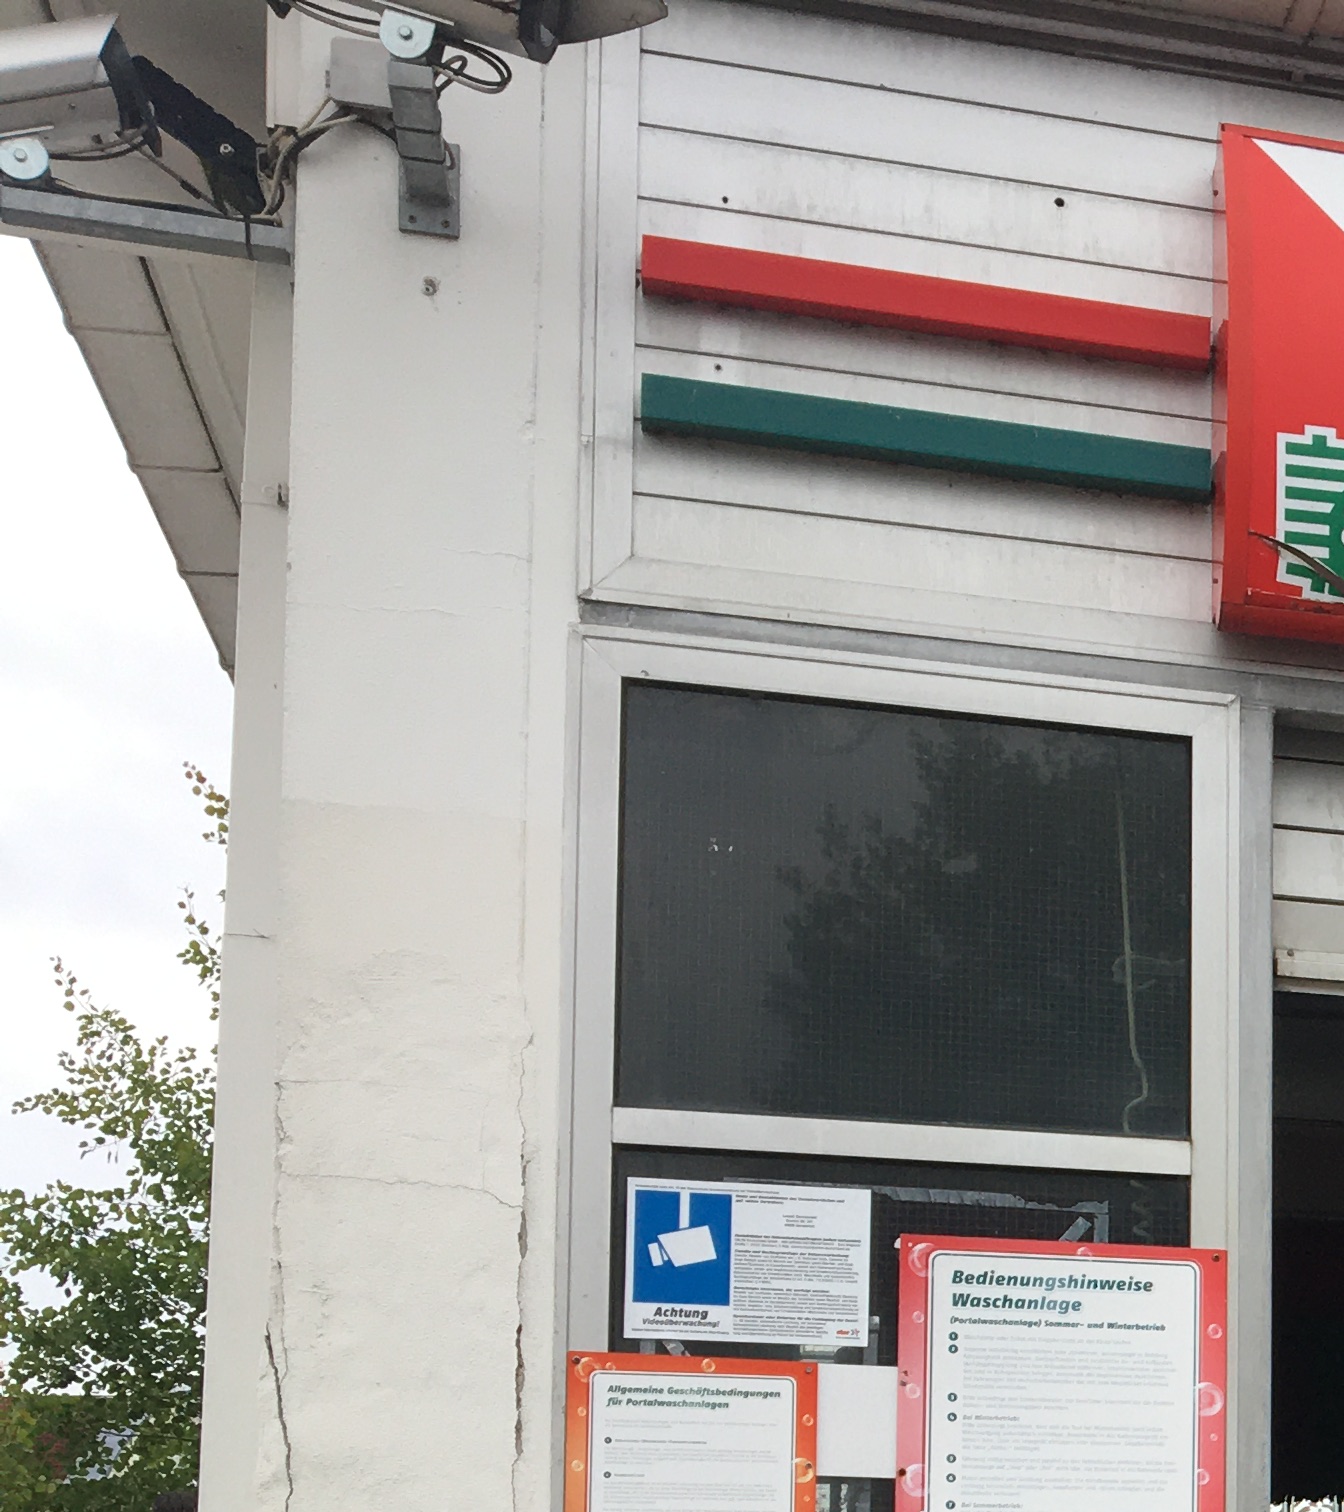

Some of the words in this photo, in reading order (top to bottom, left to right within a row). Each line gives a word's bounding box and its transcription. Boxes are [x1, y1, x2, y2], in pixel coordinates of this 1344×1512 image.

[952, 1270, 1154, 1291] Bedienungshinweise
[952, 1293, 1082, 1314] Waschanlage
[653, 1306, 709, 1320] Achtung
[642, 1318, 720, 1329] Videoüberwachung!
[950, 1316, 1042, 1328] (Portalwaschanlage)
[1044, 1318, 1084, 1329] Sommer-
[1107, 1322, 1166, 1331] Winterbetrieb
[607, 1385, 664, 1396] Allgemeine
[667, 1386, 781, 1399] Geschäftsbedingungen
[606, 1397, 623, 1407] für
[626, 1398, 729, 1410] Portalwaschanlagen
